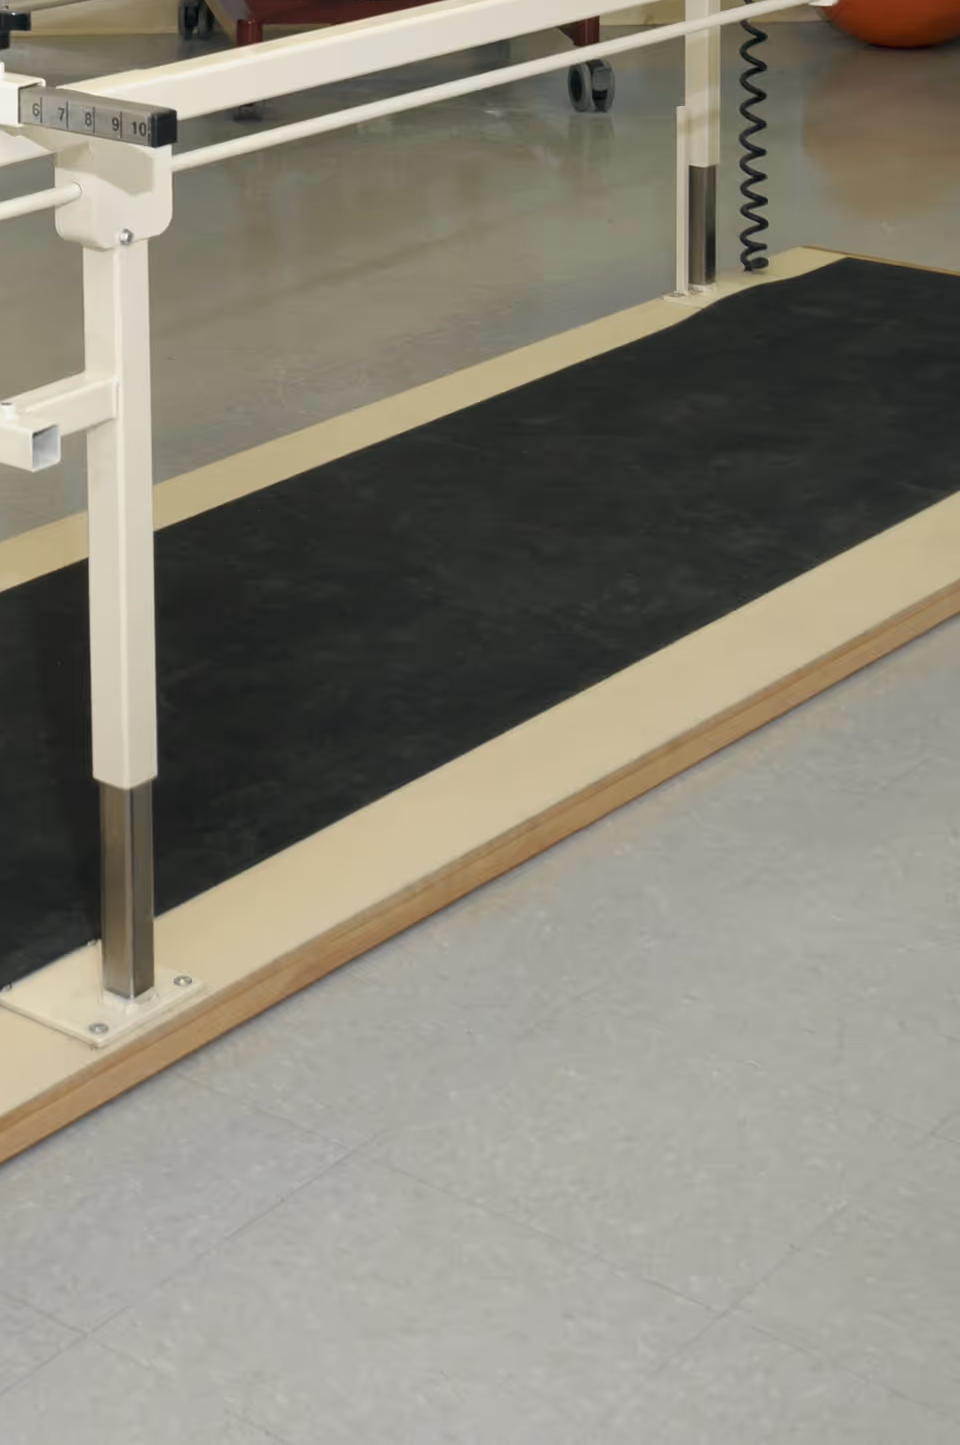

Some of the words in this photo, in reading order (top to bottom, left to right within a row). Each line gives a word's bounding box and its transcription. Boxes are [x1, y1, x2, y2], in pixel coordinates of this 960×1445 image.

[32, 102, 40, 117] 6
[58, 106, 66, 122] 7
[84, 111, 93, 127] 8
[111, 116, 120, 132] 9
[131, 121, 147, 137] 10
